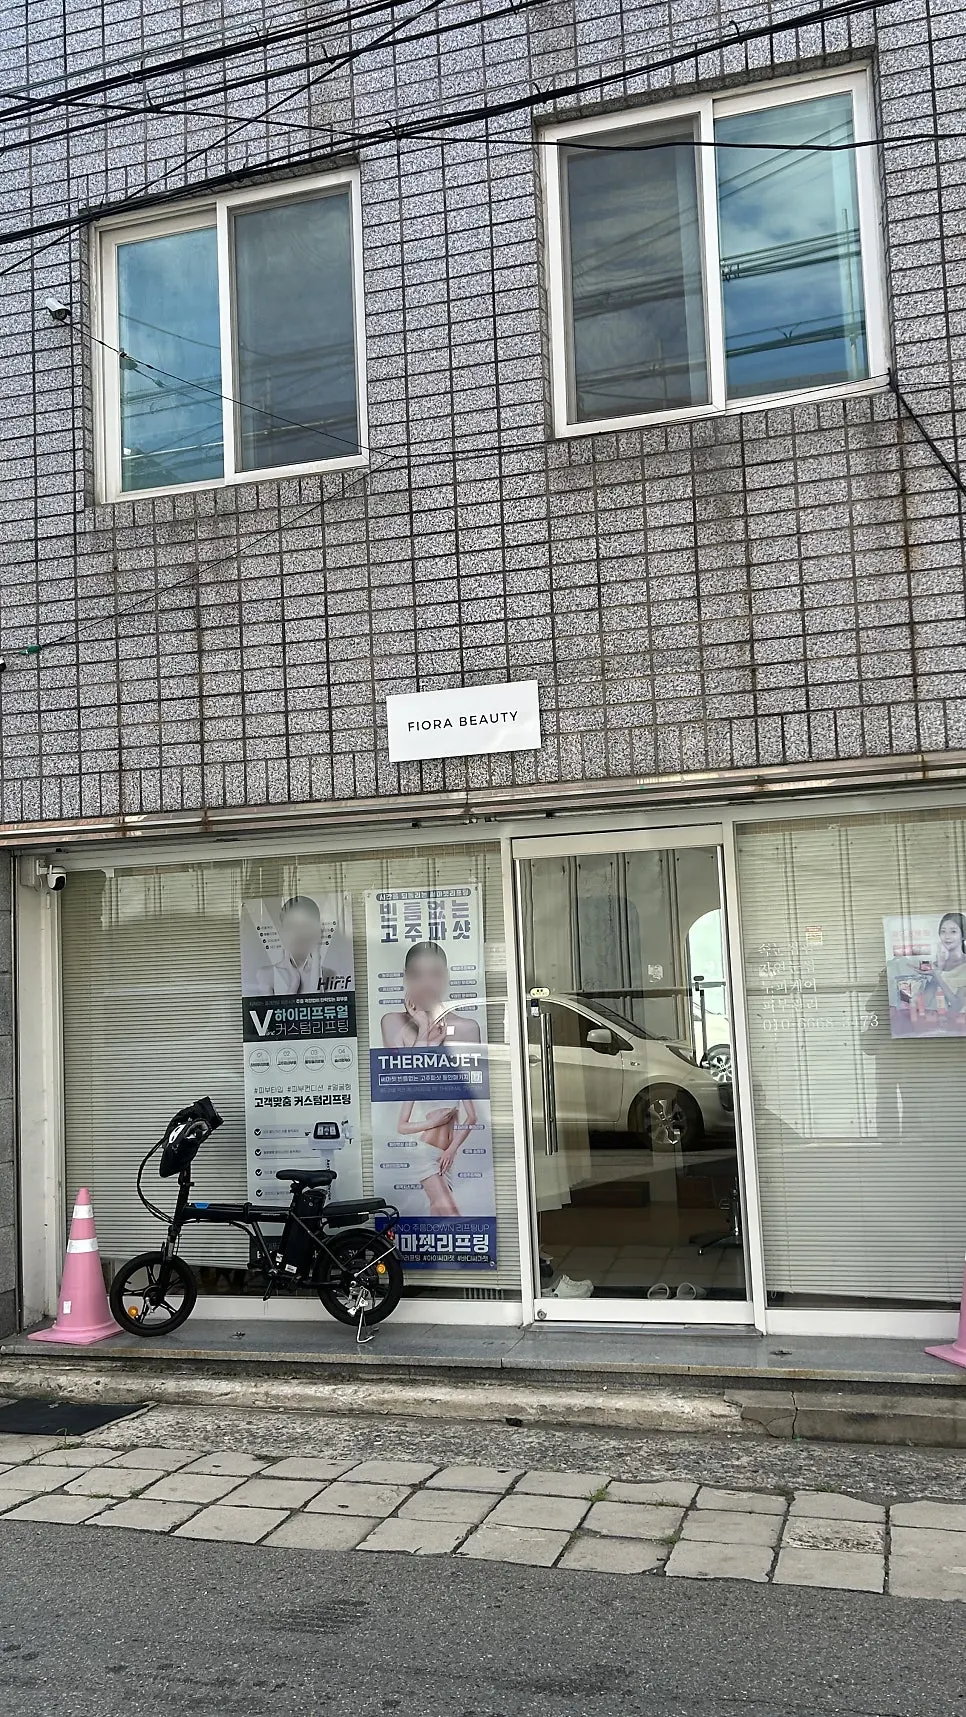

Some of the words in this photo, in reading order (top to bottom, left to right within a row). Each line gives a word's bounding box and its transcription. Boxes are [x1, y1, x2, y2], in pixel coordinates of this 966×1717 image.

[407, 718, 453, 732] FIORA
[459, 711, 518, 726] BEAUTY
[379, 900, 470, 923] 빈틈없는
[380, 920, 471, 943] 고주파샷
[274, 1005, 349, 1021] 하이리프듀얼
[276, 1020, 350, 1036] 커스텀리프팅
[378, 1053, 482, 1070] THERMAJET
[254, 1085, 284, 1094] #피부타입
[287, 1084, 324, 1093] #피부컨디션
[254, 1096, 291, 1108] 고객맞춤
